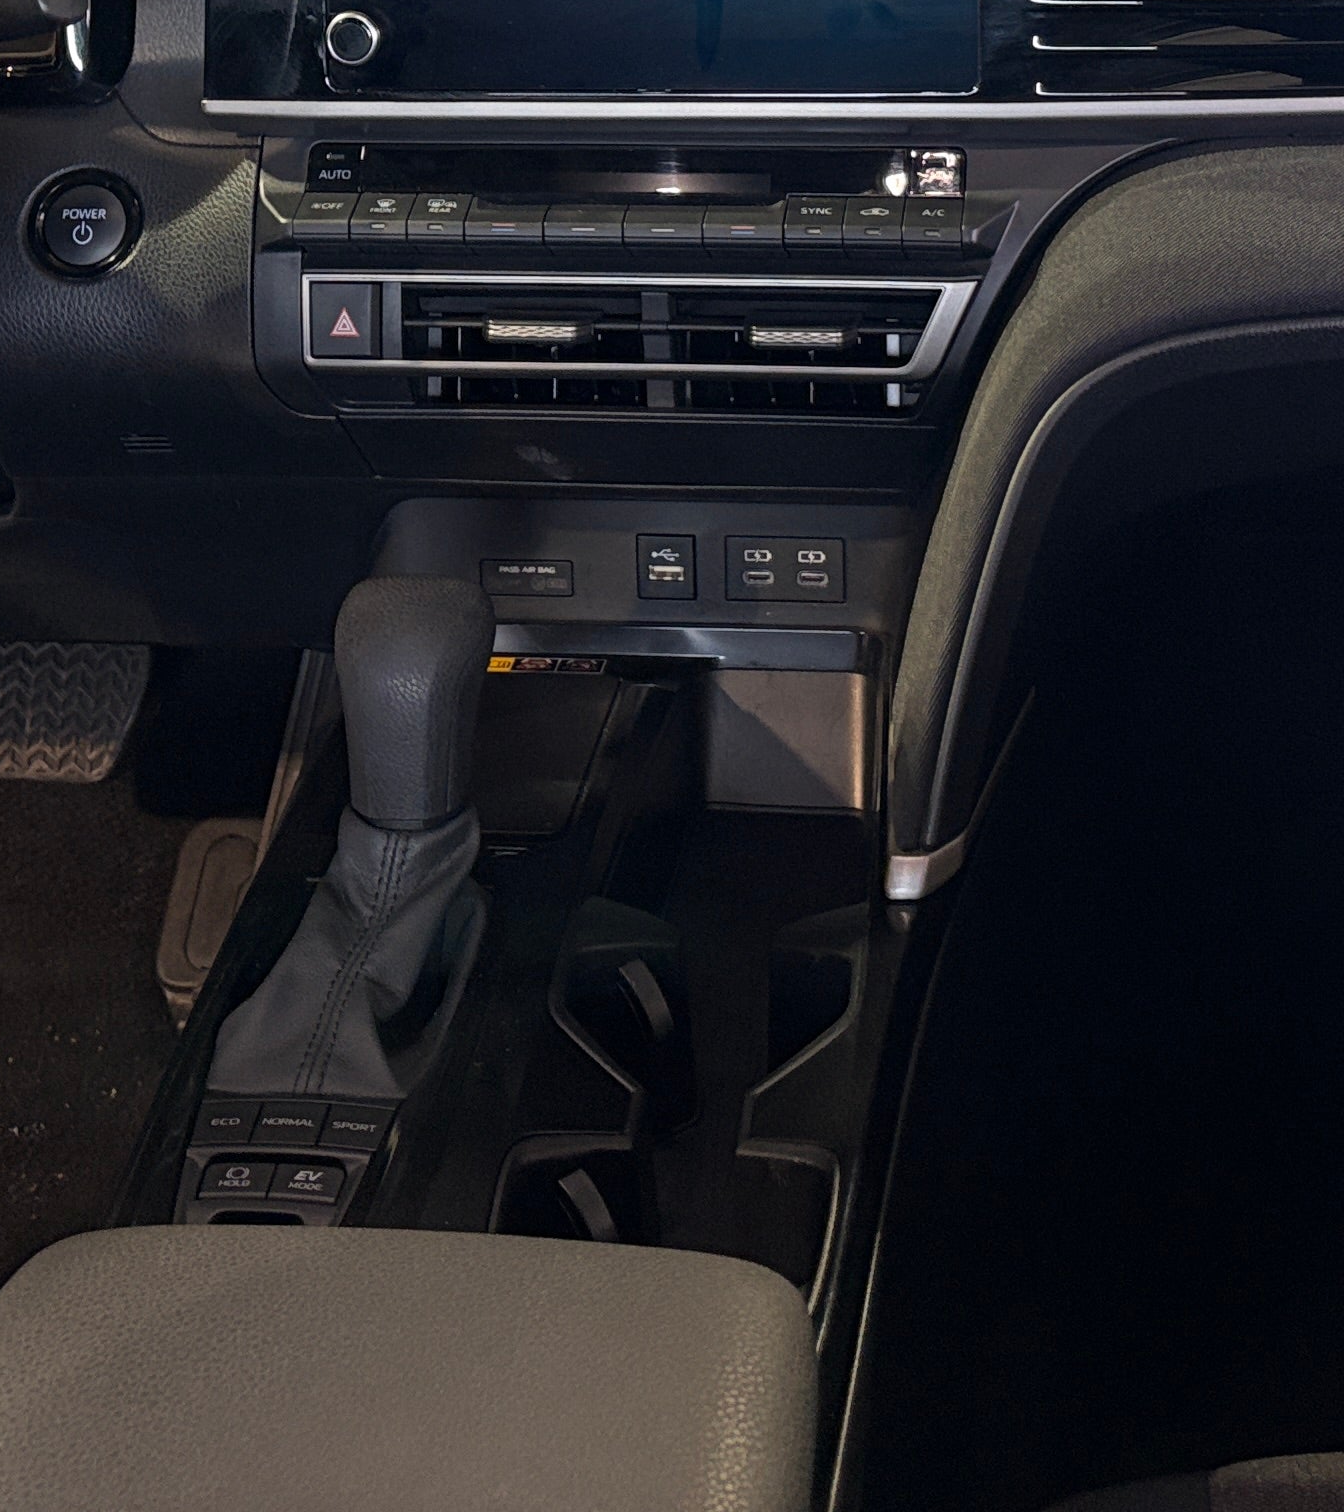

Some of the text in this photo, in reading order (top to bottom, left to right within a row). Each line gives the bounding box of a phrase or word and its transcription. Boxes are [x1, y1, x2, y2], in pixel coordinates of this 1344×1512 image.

[318, 169, 352, 180] AUTO
[322, 201, 345, 210] OFF
[62, 208, 107, 220] POWER
[800, 207, 833, 215] SYNC
[921, 209, 945, 217] A/C
[521, 566, 537, 574] AIR
[537, 566, 556, 574] BAG
[211, 1117, 241, 1127] ECO
[261, 1117, 315, 1128] NORMAL
[332, 1120, 377, 1133] SPORT
[293, 1170, 324, 1182] EV
[218, 1179, 251, 1188] HOLD
[288, 1181, 324, 1191] MODE
